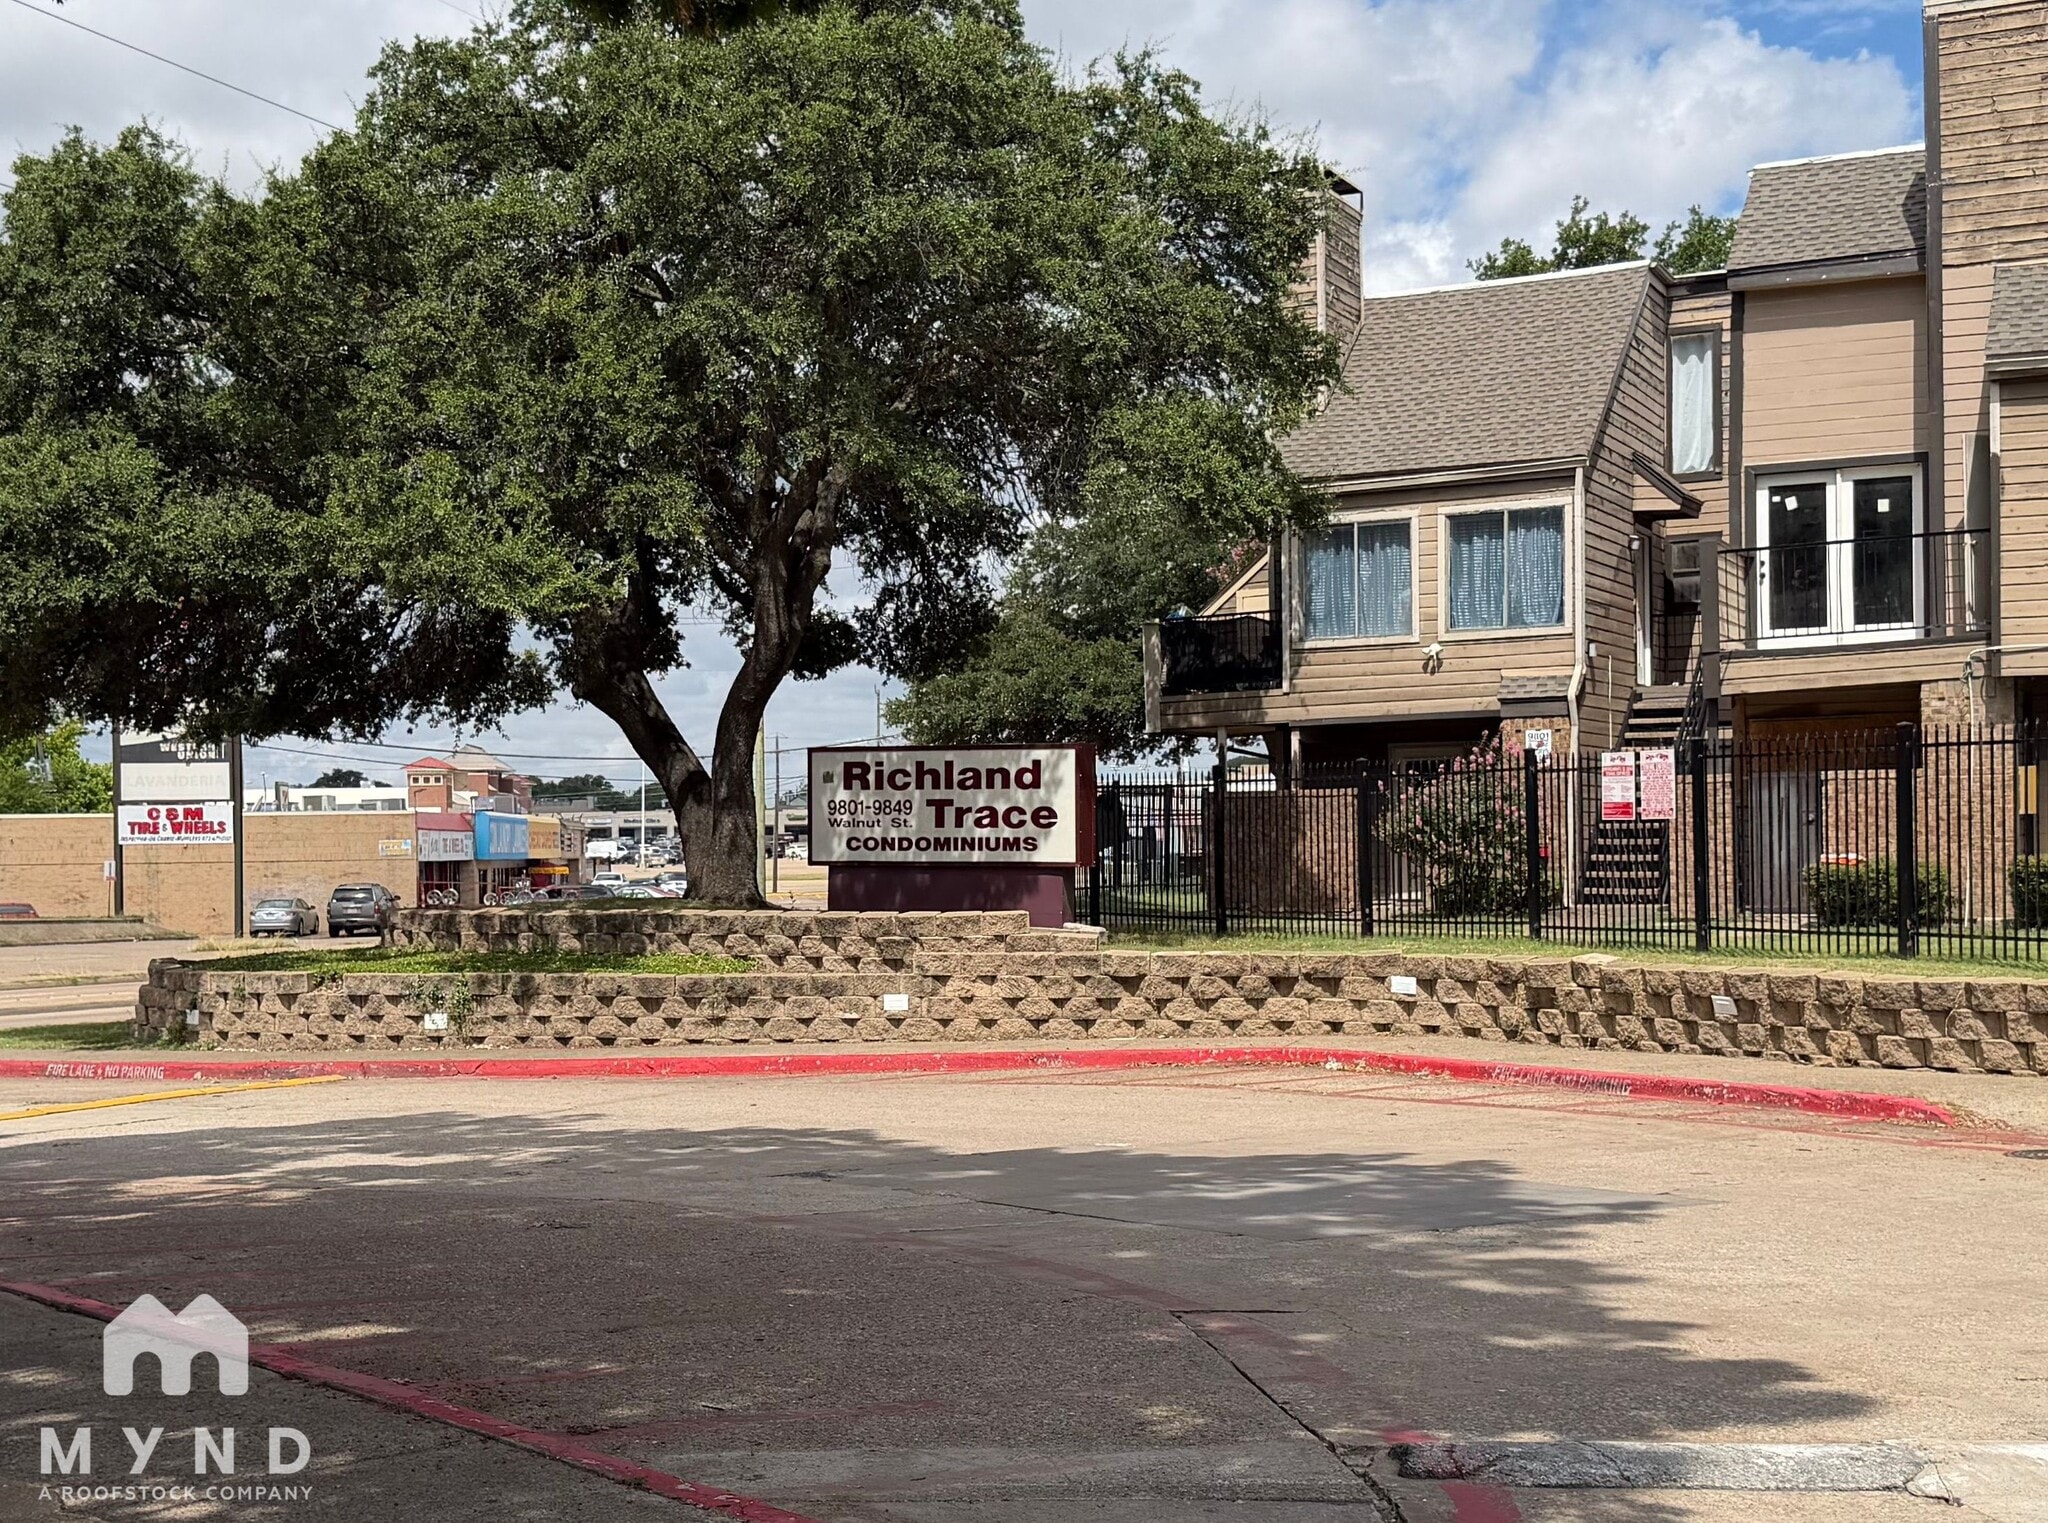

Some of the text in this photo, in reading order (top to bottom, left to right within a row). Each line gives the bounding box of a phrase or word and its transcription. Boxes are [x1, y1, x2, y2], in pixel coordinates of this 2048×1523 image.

[127, 775, 225, 787] LAVANDERIA
[843, 759, 1042, 791] Richland
[147, 807, 203, 820] C & M
[827, 799, 913, 816] 9801-9849
[925, 798, 1059, 830] Trace
[128, 821, 160, 835] TIRE
[170, 820, 227, 835] WHEELS
[828, 817, 913, 828] Walnut St.
[846, 836, 1038, 852] CONDOMINIUMS
[46, 1063, 164, 1080] FIRE LANE NO PARKING
